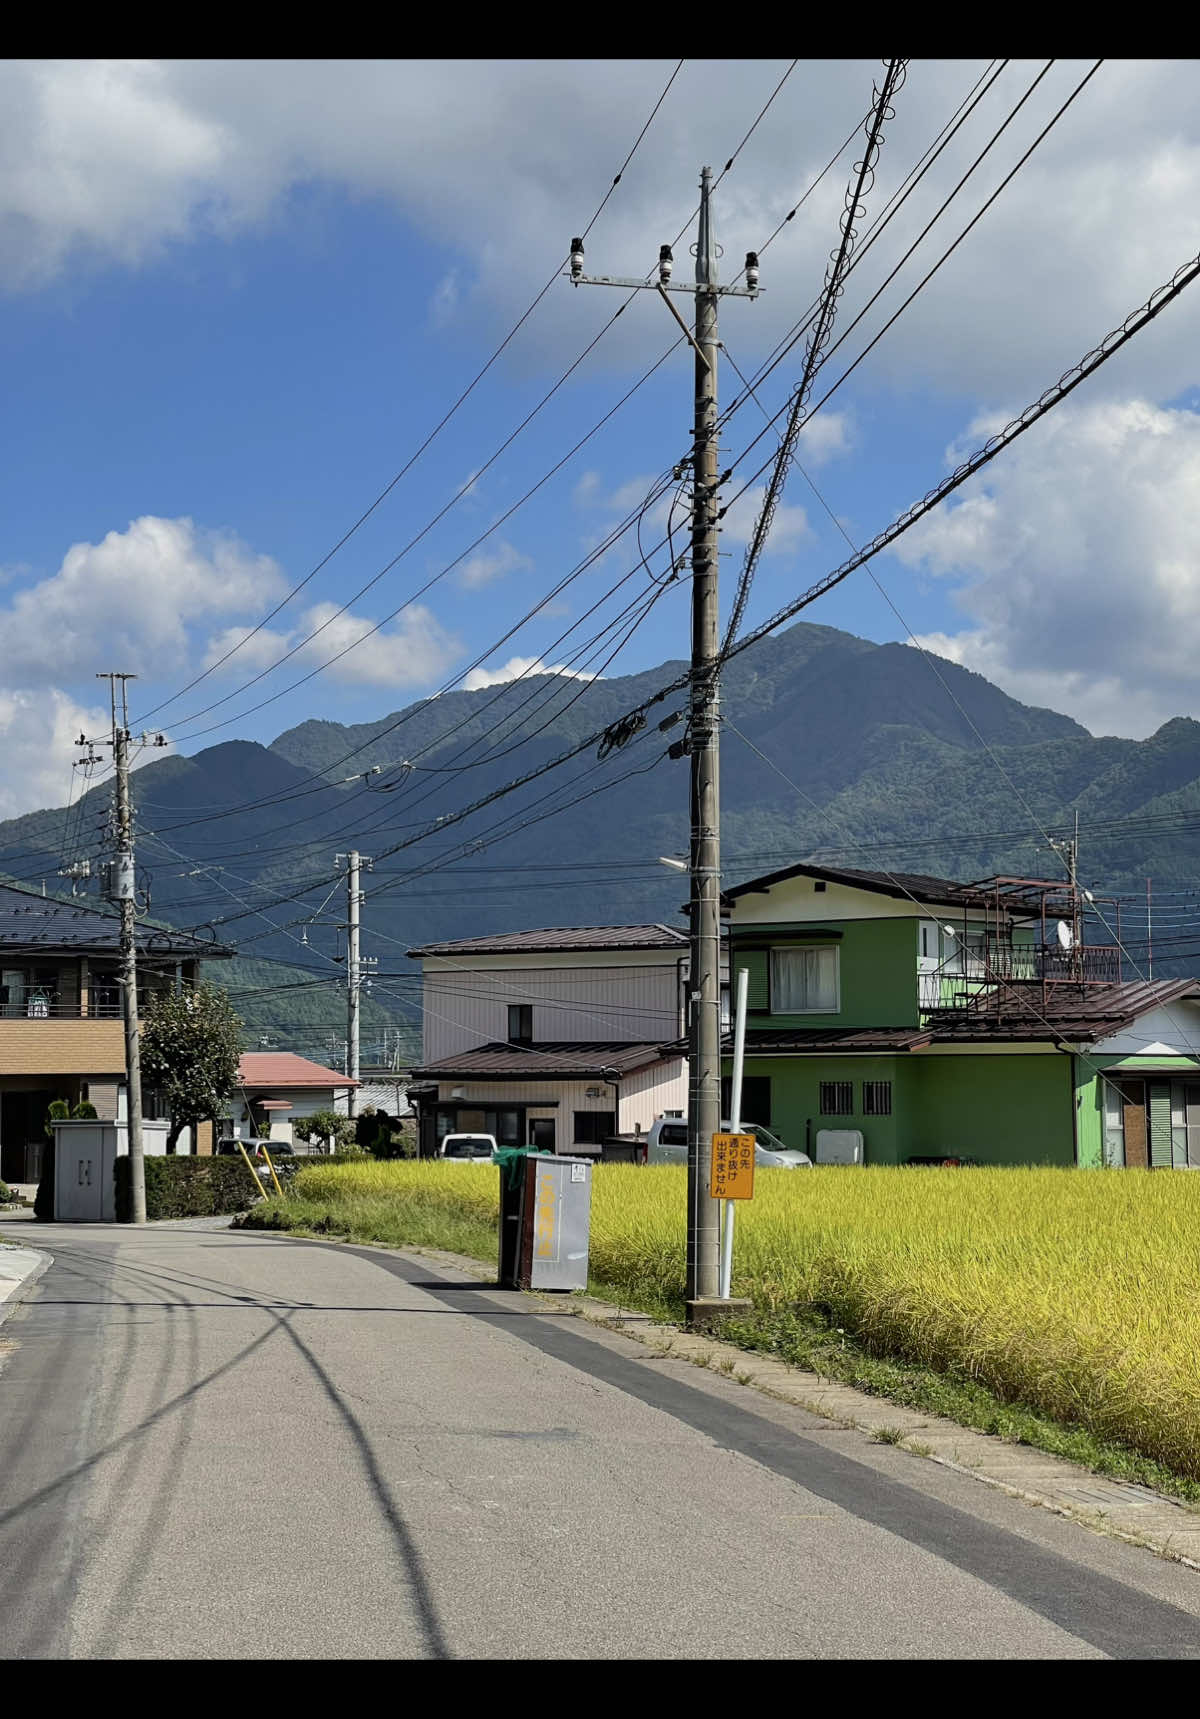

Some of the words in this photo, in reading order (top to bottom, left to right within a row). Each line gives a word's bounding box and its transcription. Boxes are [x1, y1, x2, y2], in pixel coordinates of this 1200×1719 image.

[715, 1140, 727, 1194] 出来ません
[727, 1137, 739, 1181] 通り抜け
[740, 1137, 751, 1169] この先
